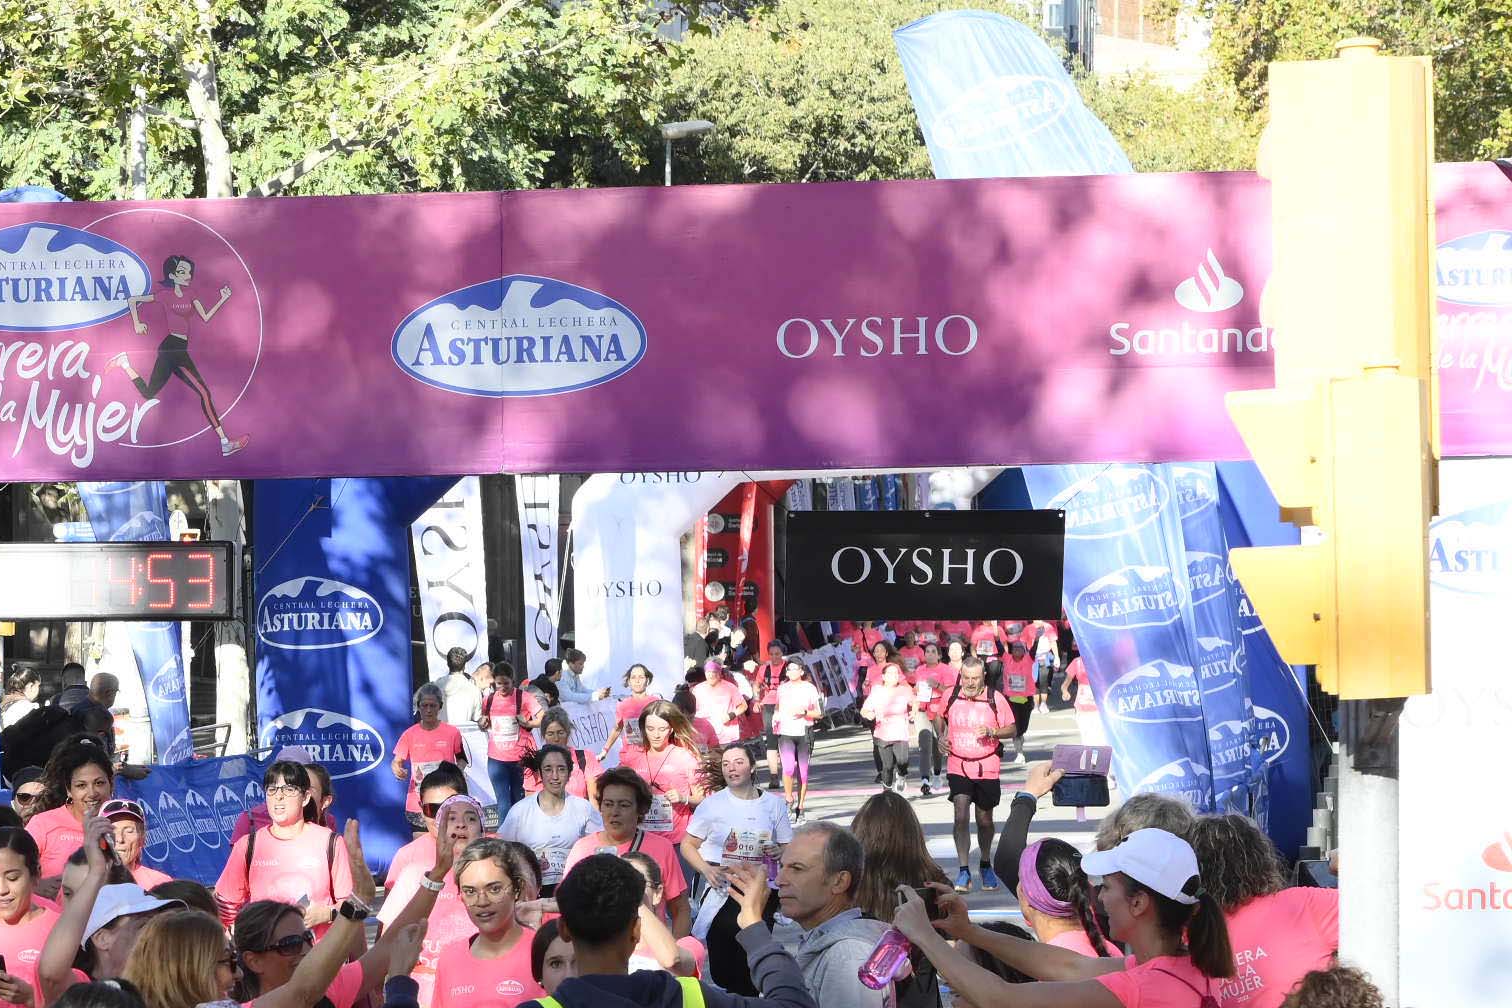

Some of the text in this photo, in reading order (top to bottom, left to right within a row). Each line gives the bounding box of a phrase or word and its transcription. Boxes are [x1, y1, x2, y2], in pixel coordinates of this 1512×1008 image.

[53, 259, 127, 270] LECHERA
[450, 316, 618, 331] CENTRAL LECHERA
[776, 314, 978, 359] OYSHO
[411, 322, 627, 367] ASTURIANA
[11, 375, 161, 468] Mujer
[830, 545, 1025, 588] OYSHO
[261, 606, 374, 633] ASTURIANA
[273, 599, 370, 611] CENTRAL LECHERA
